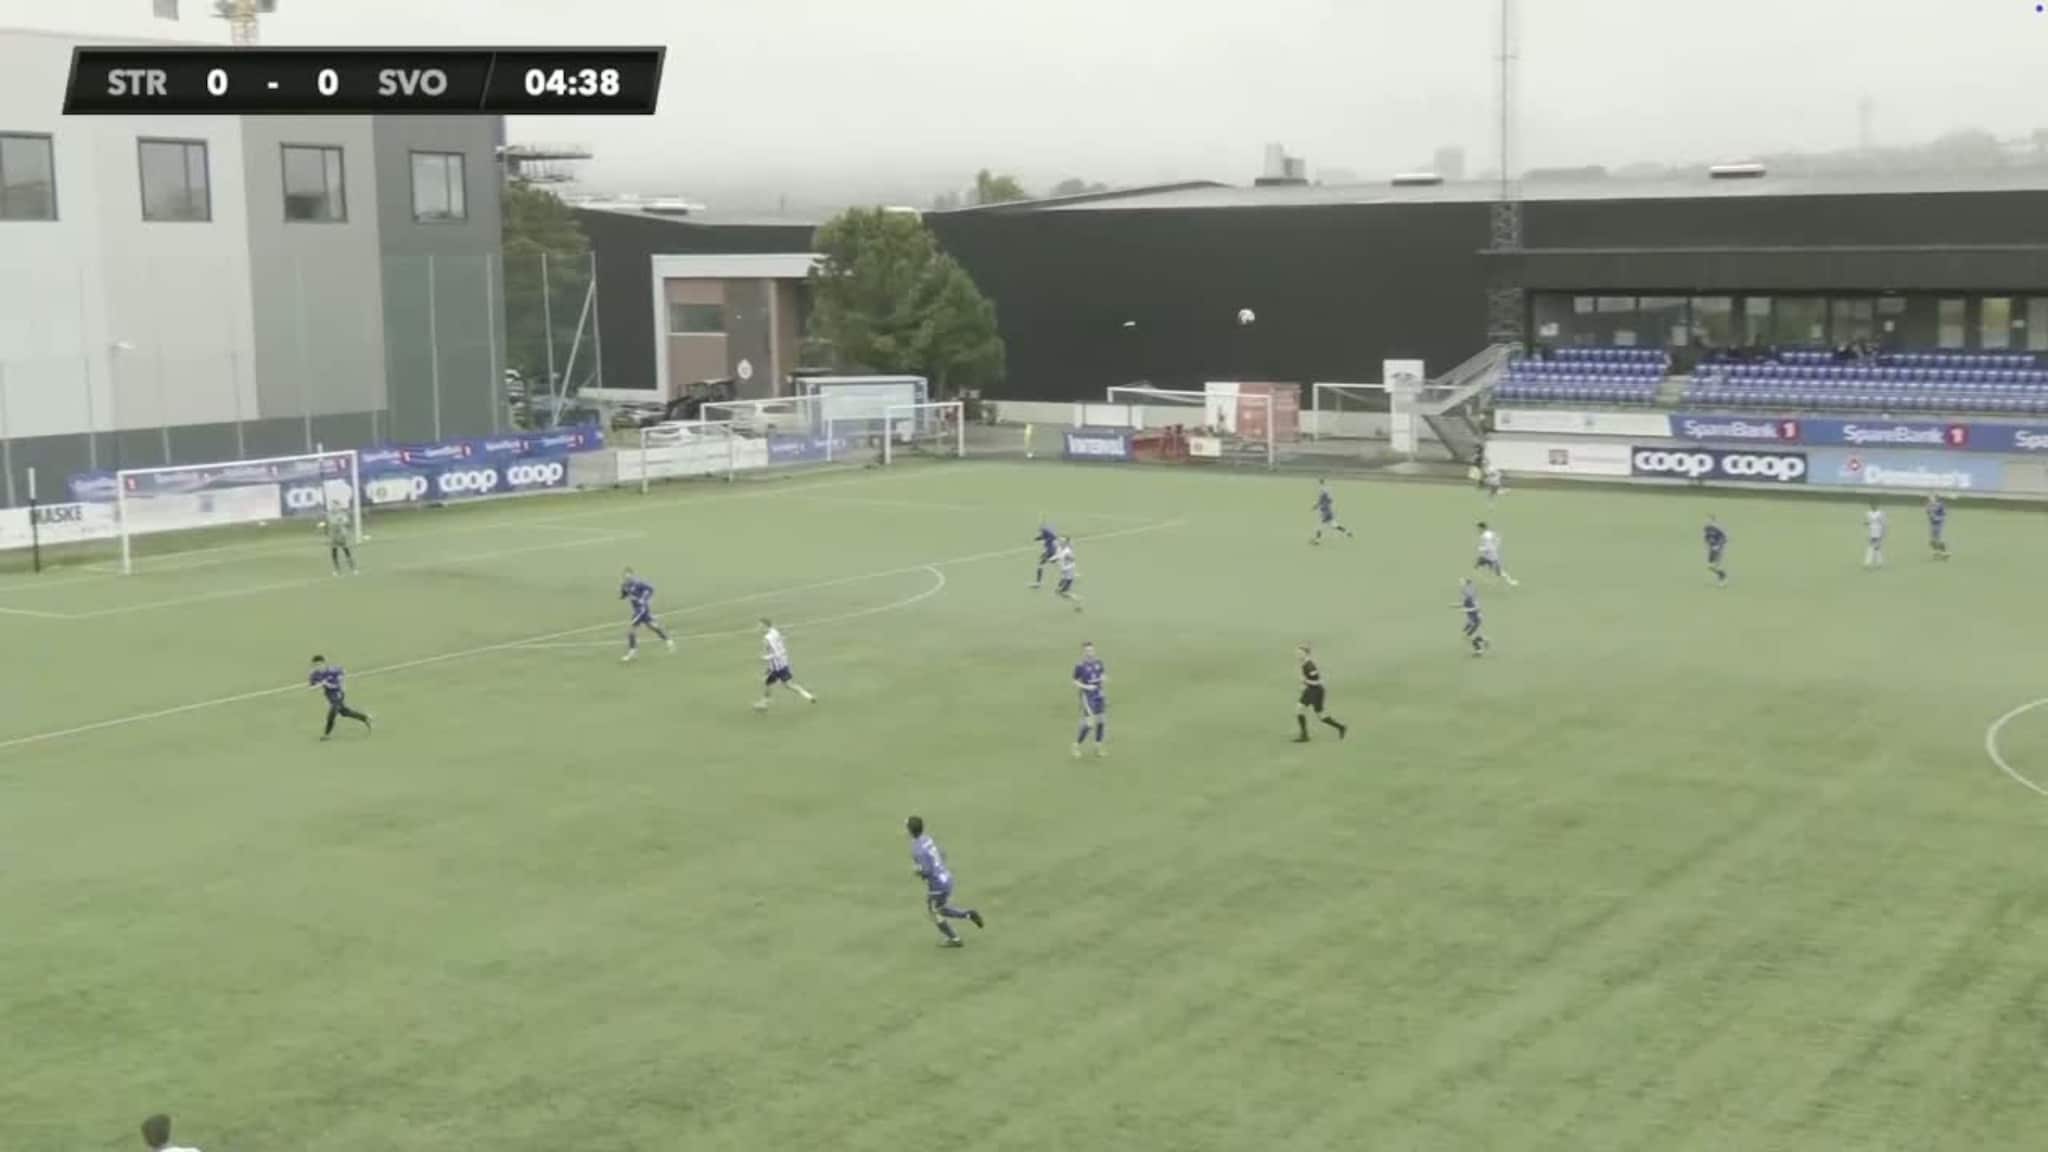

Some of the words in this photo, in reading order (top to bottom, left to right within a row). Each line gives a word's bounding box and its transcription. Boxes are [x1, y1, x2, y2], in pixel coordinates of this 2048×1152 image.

[438, 468, 498, 492] coop
[507, 463, 563, 486] coop
[1634, 450, 1714, 477] coop
[1722, 452, 1805, 480] coop
